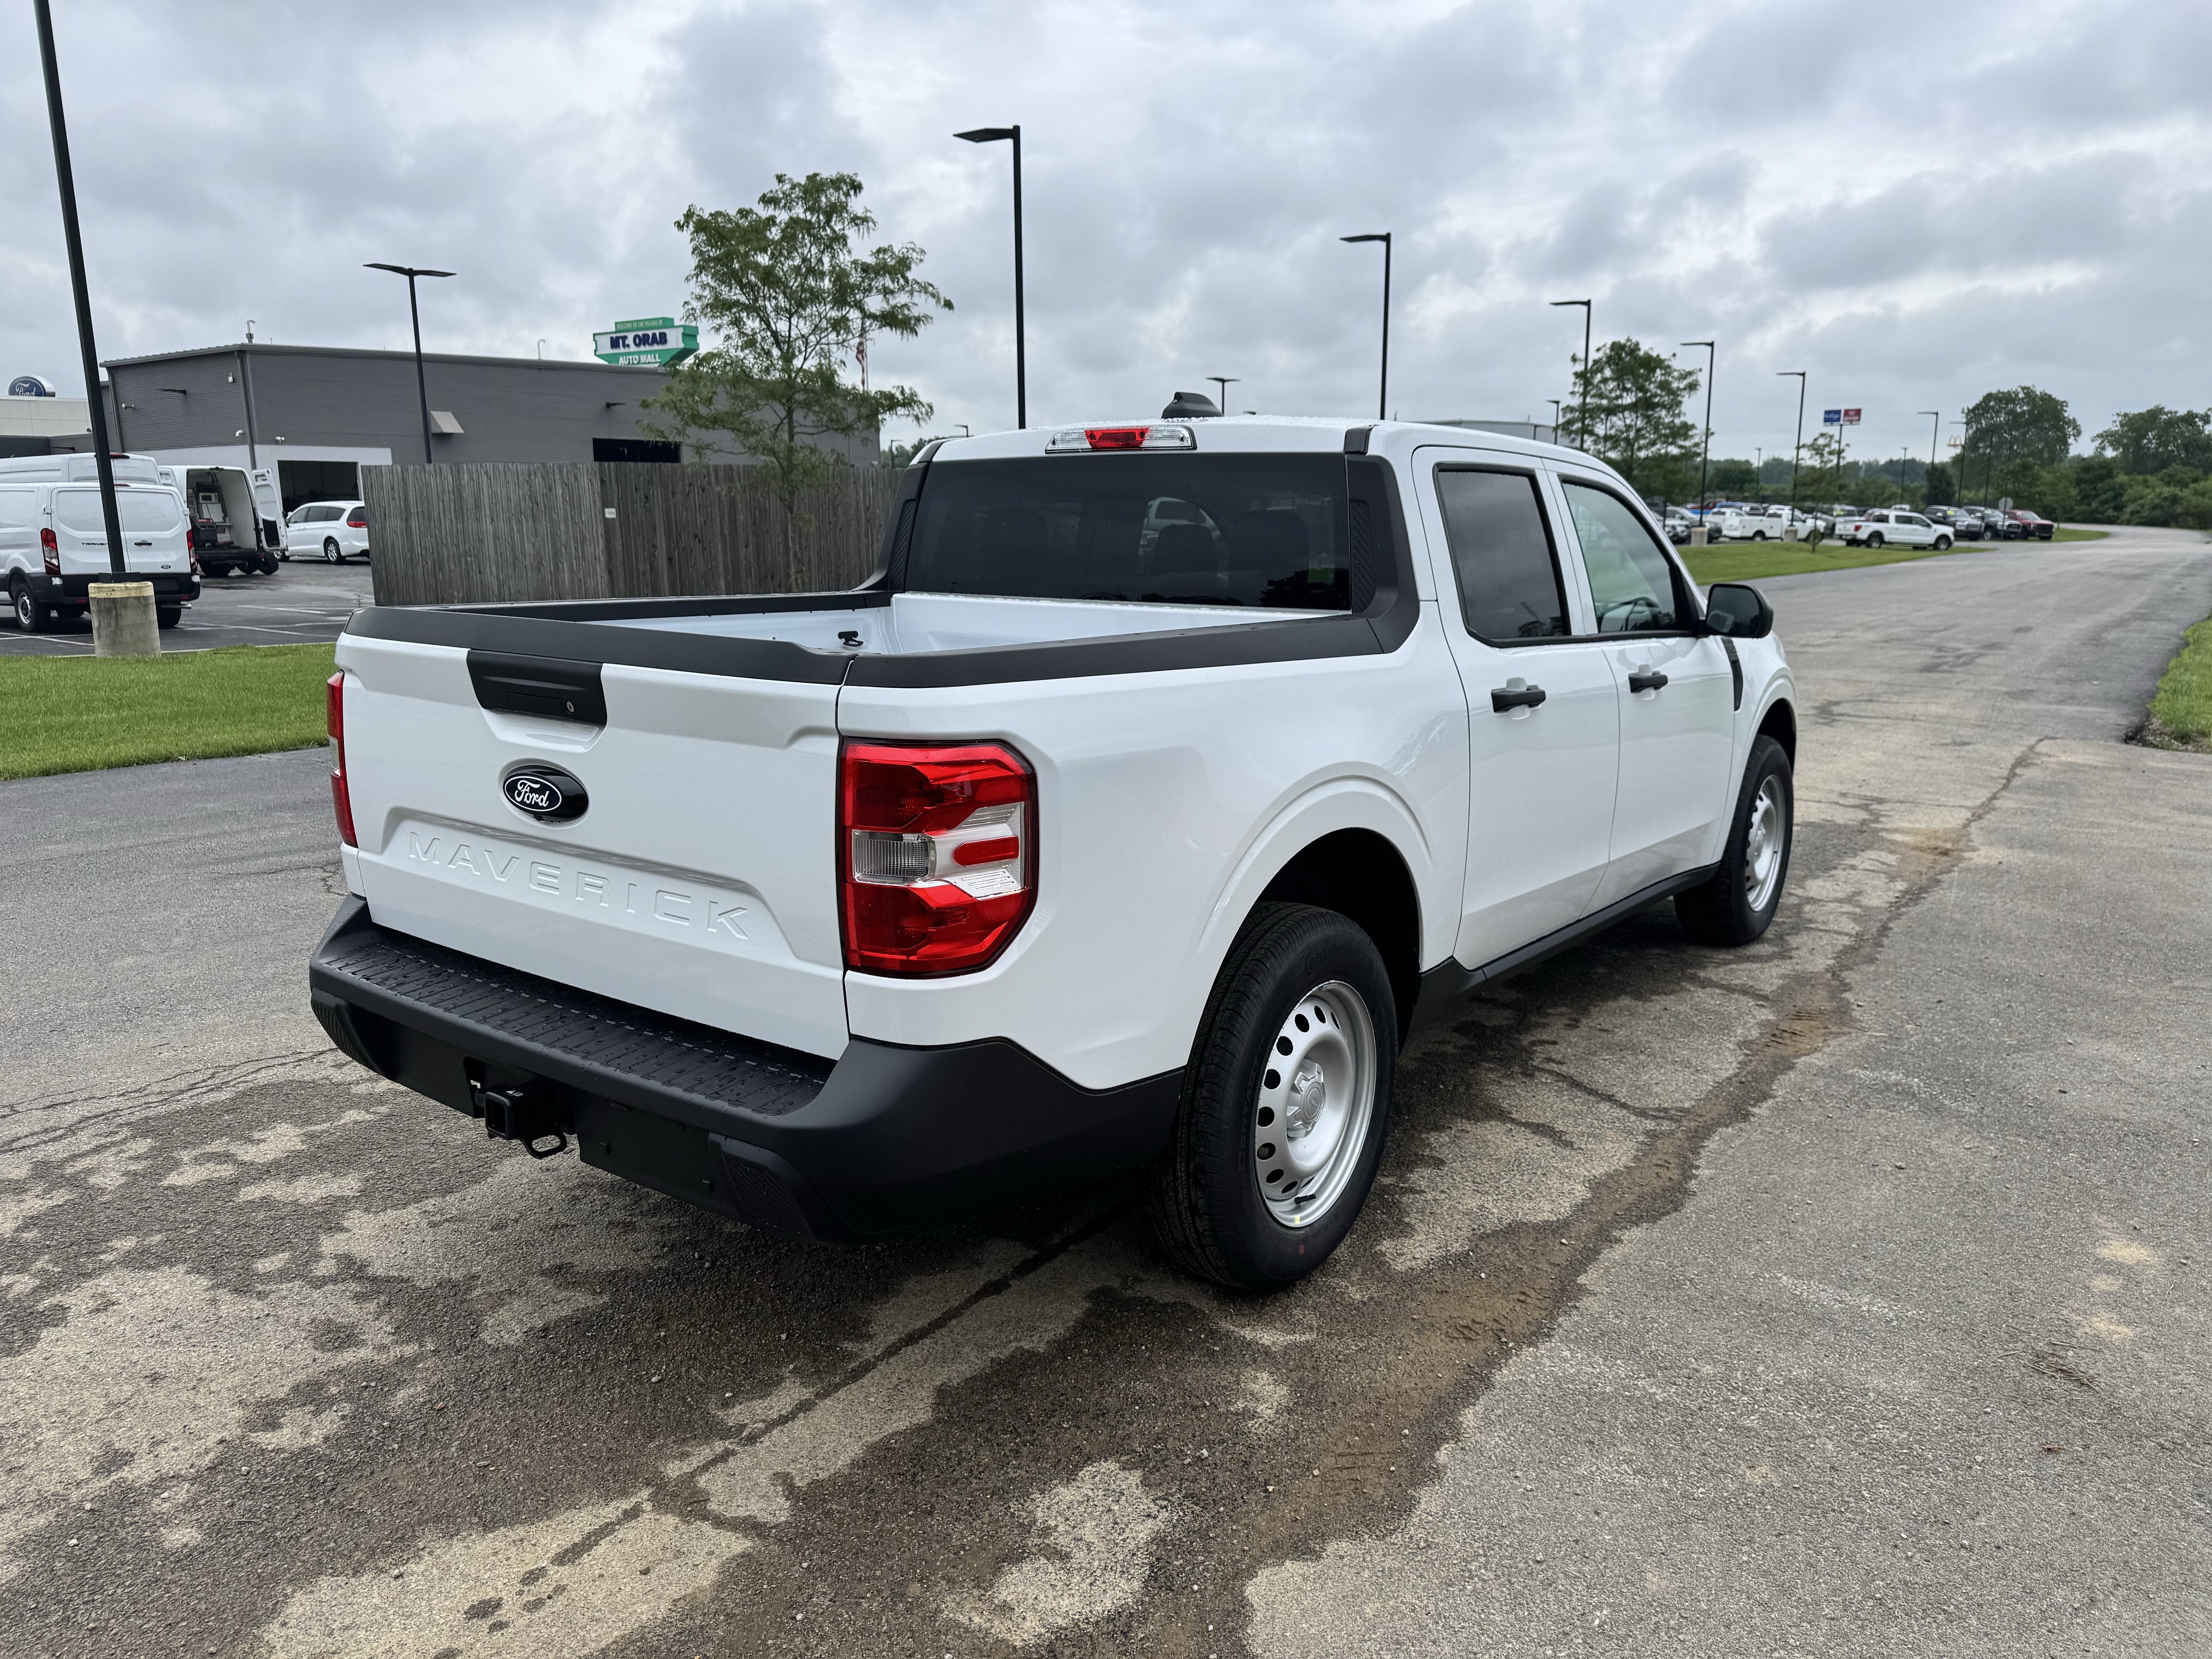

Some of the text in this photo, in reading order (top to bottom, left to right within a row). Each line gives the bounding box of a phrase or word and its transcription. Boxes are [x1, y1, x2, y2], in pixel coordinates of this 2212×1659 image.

[610, 331, 667, 349] MT. ORAB
[619, 354, 661, 365] AUTO MALL
[515, 780, 550, 807] Ford
[409, 831, 749, 939] MAVERICK
